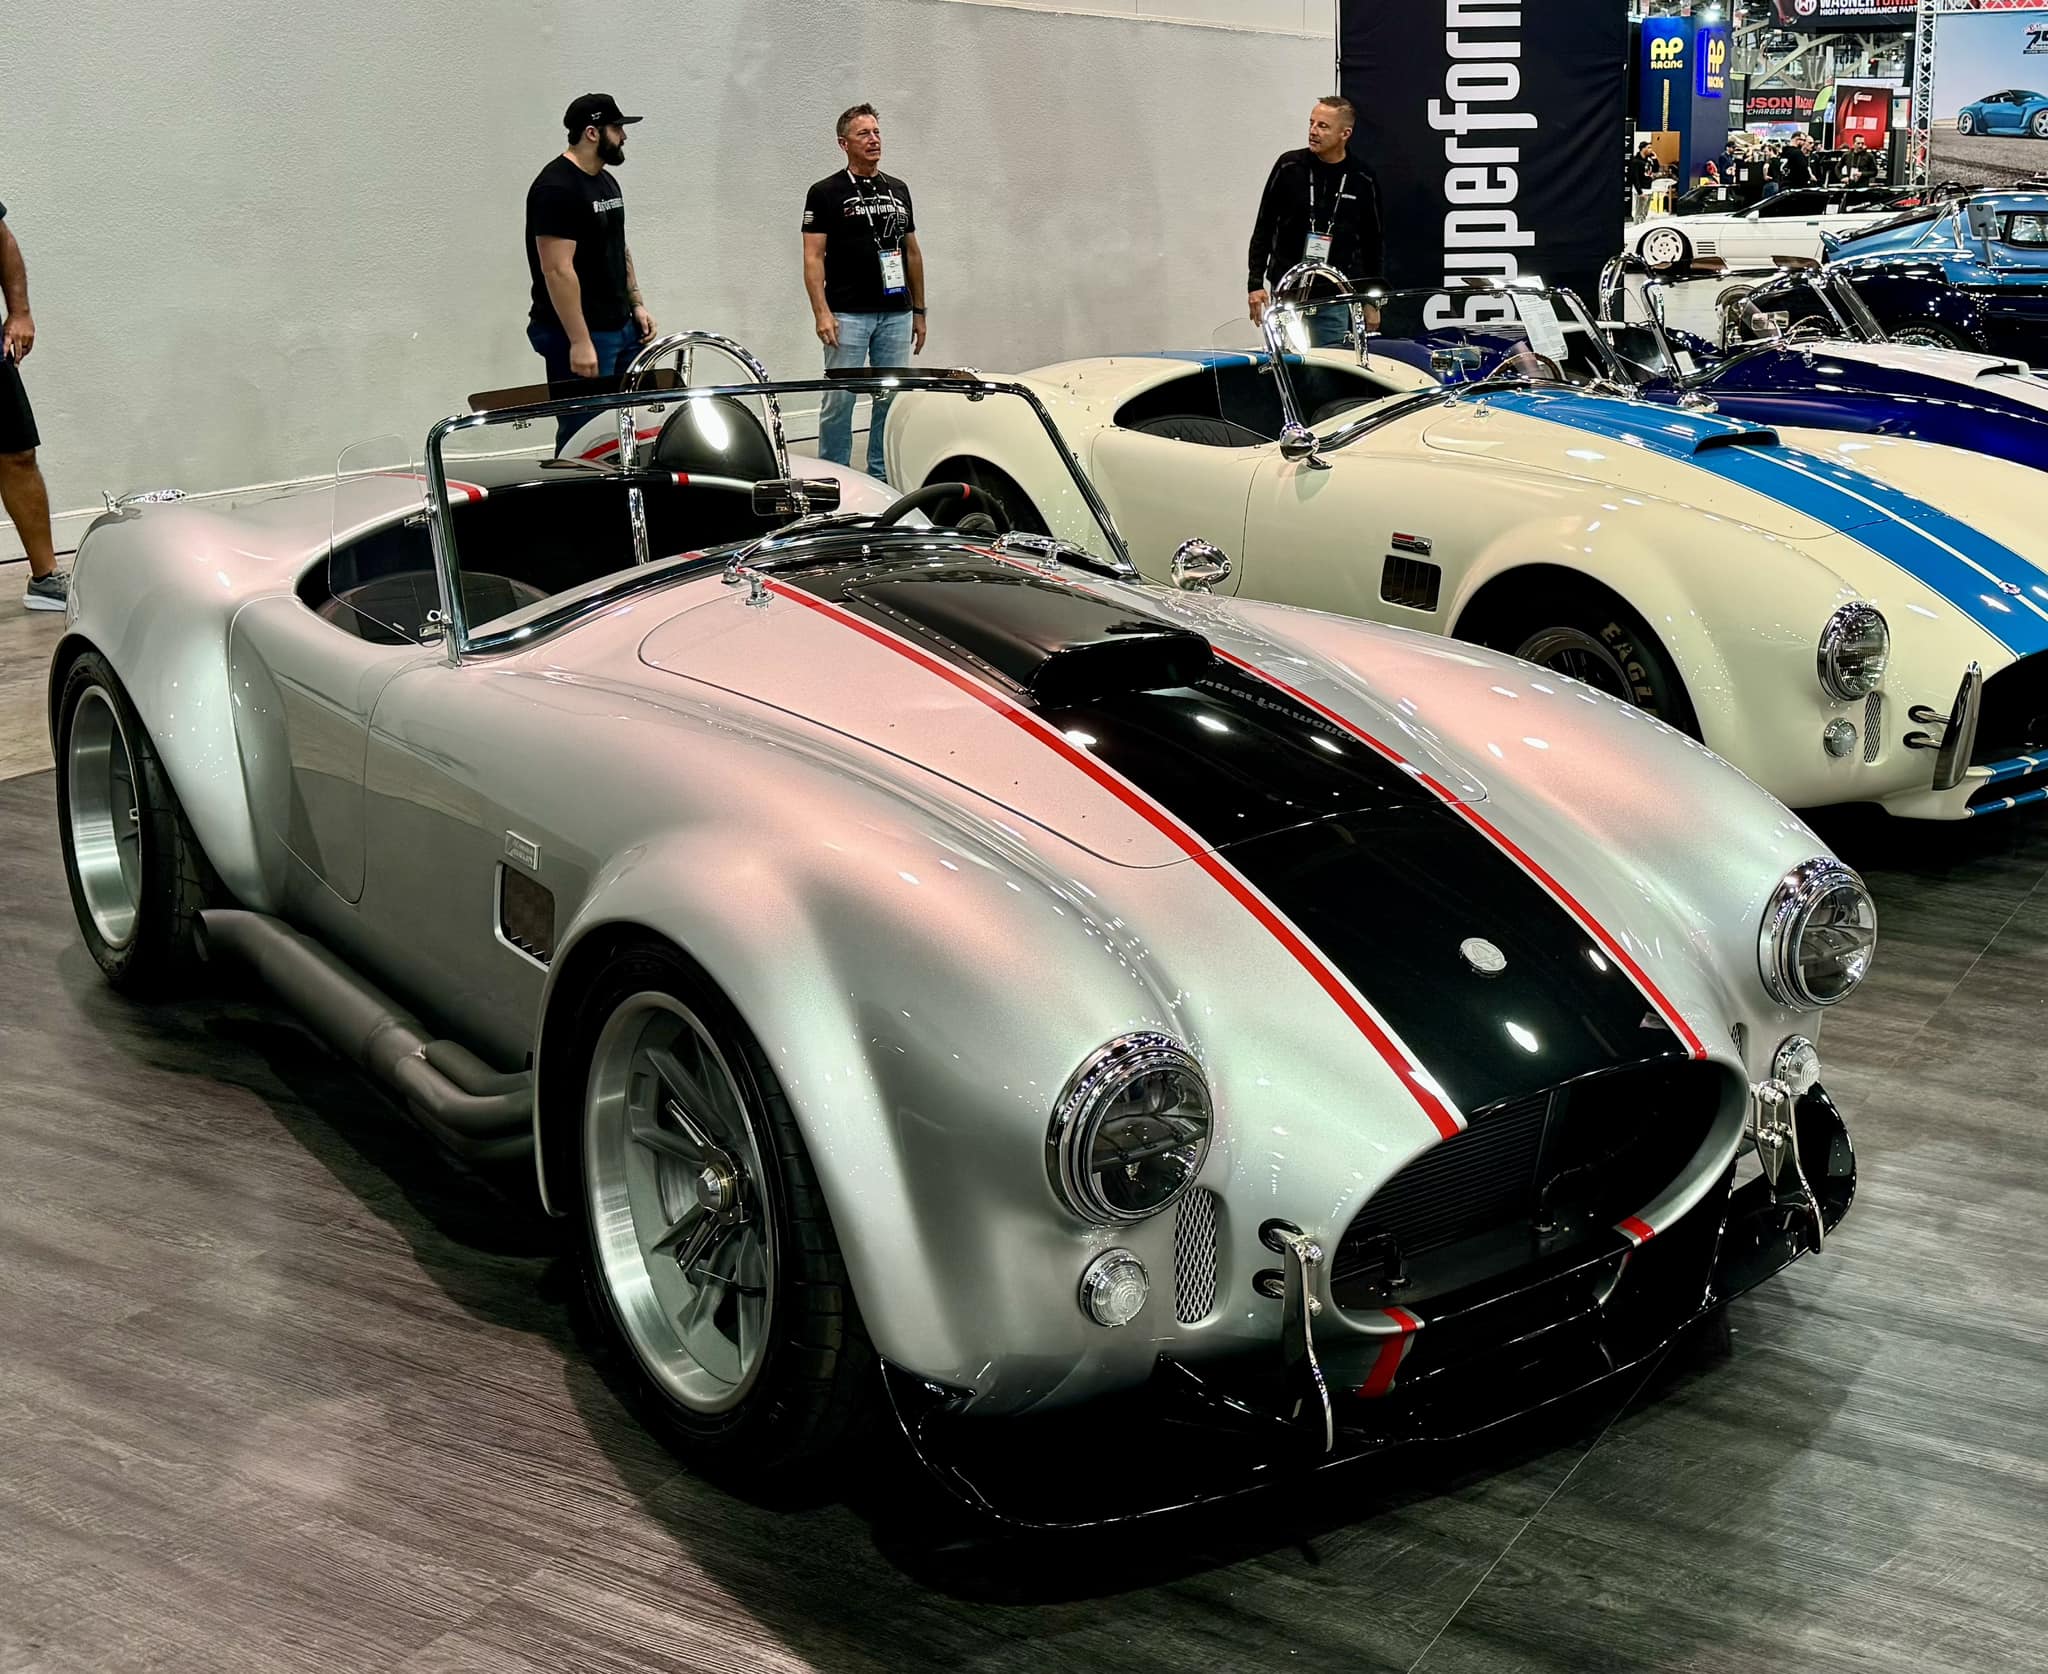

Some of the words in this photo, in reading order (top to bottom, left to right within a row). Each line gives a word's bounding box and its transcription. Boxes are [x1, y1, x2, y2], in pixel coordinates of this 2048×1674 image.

[1820, 8, 1838, 16] HIGH
[1840, 6, 1898, 15] PERFORMANCE
[1650, 37, 1684, 60] AP
[1650, 60, 1684, 70] RACING
[1600, 621, 1655, 704] EAGL
